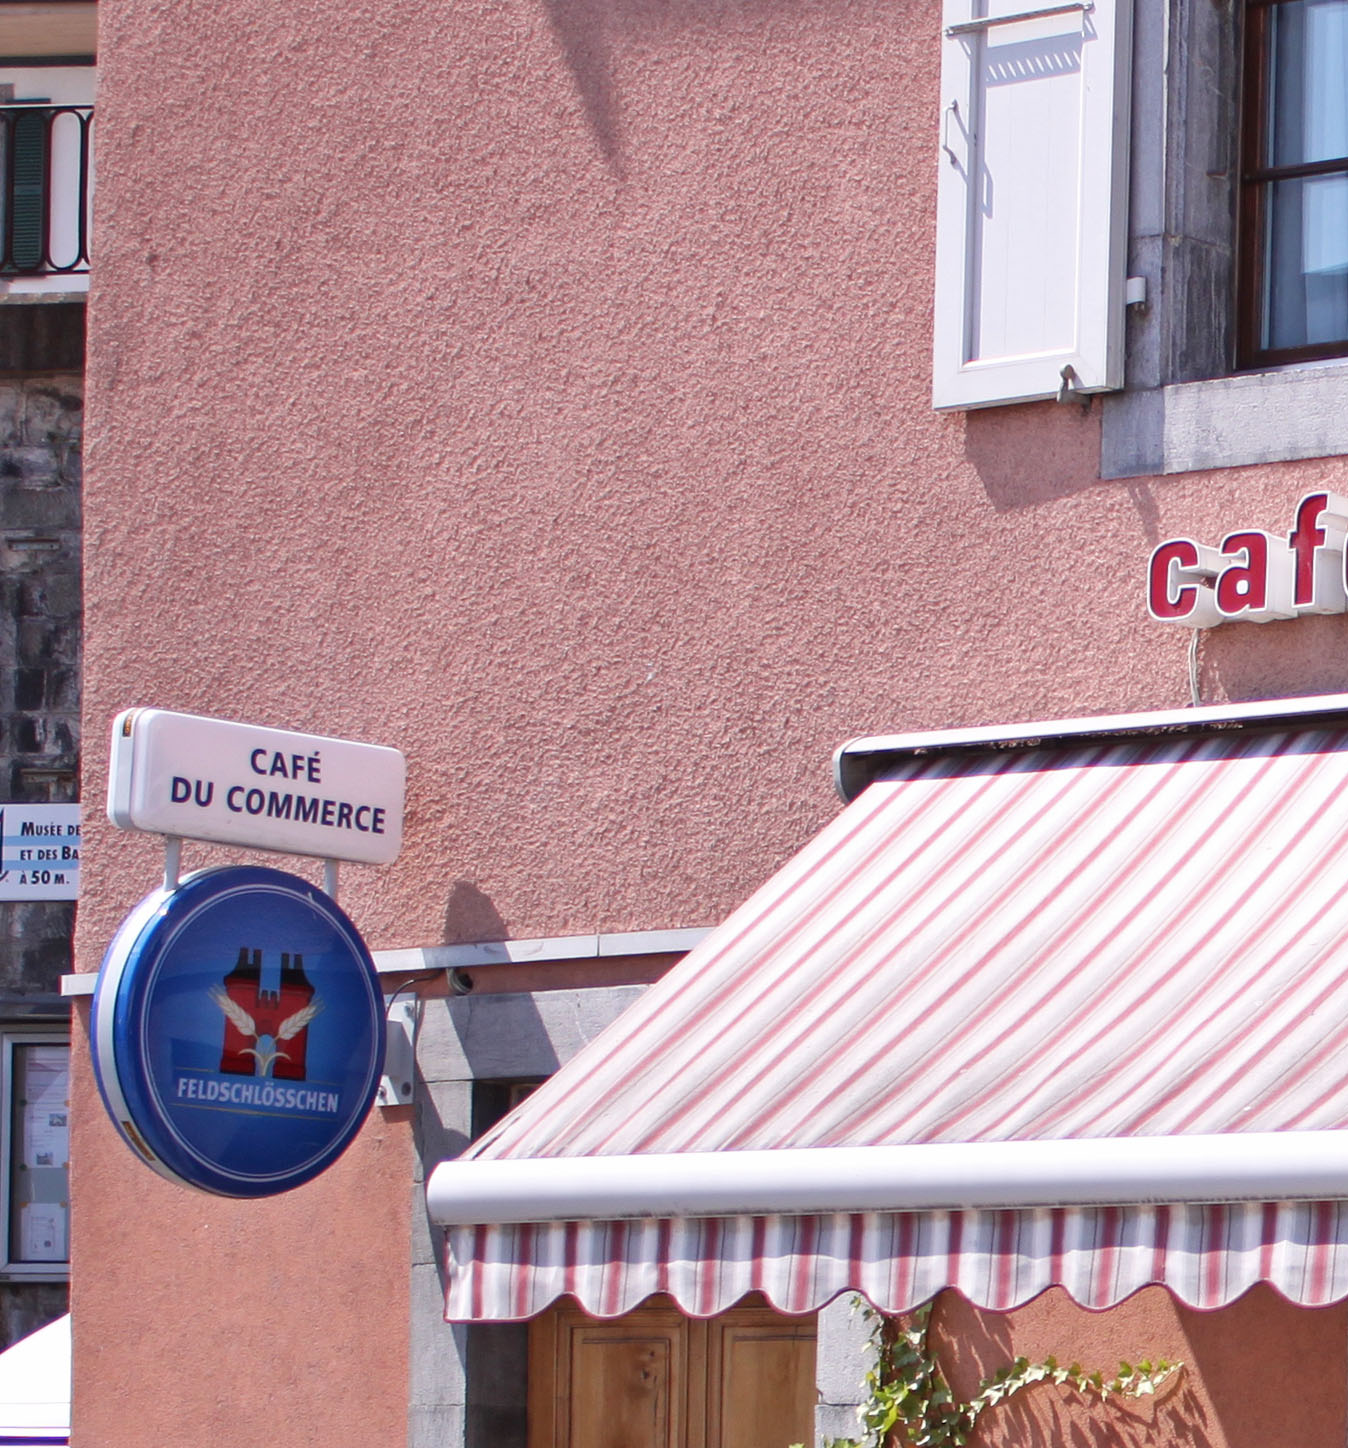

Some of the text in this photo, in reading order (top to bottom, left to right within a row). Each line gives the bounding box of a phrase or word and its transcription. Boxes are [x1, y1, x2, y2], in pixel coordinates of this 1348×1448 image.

[250, 748, 322, 784] CAFÉ
[170, 776, 386, 834] DU COMMERCE
[20, 849, 32, 860] ET
[37, 849, 58, 860] DES
[31, 870, 51, 884] 50
[177, 1077, 339, 1113] FELDSCHLÖSSCHEN
